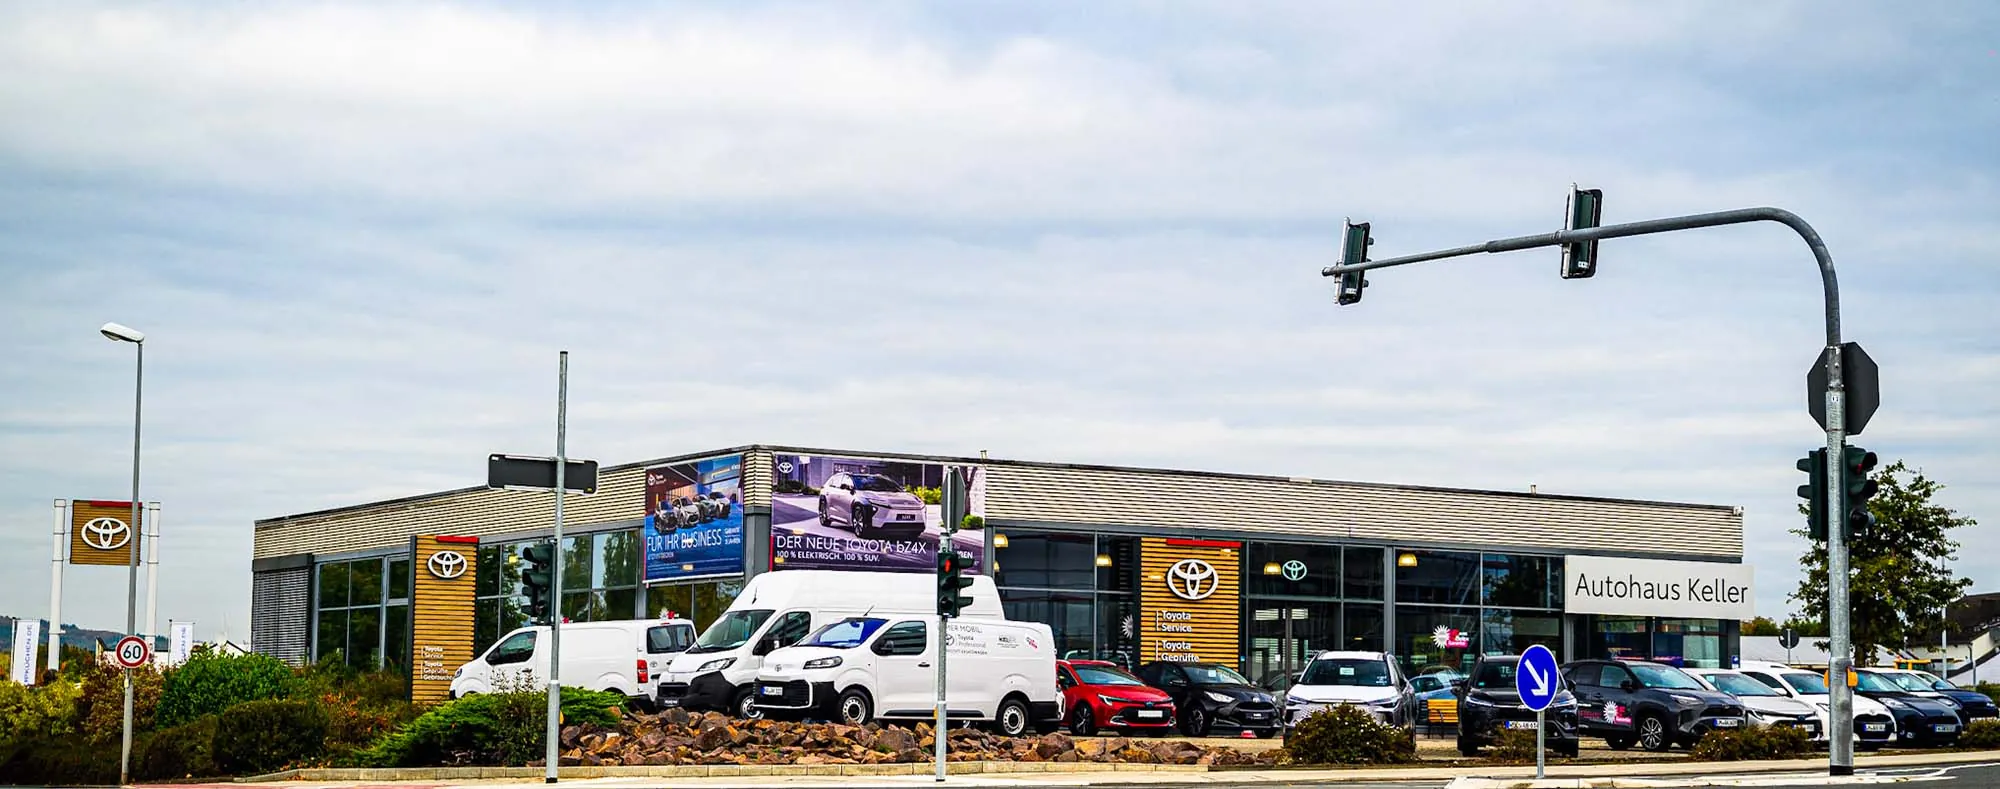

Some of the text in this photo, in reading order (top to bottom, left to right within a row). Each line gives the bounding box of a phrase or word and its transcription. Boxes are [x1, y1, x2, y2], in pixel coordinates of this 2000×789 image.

[664, 532, 679, 551] IHR
[681, 529, 722, 549] BUSINESS
[776, 535, 927, 555] DER NEUE TOYOTA bZ4X
[776, 550, 880, 562] 100 % ELEKTRISCH. 100 % SUV.
[1574, 572, 1748, 604] Autohaus Keller
[1161, 609, 1192, 622] Toyota
[1161, 622, 1193, 632] Service
[123, 644, 142, 660] 60
[423, 645, 443, 653] Toyota
[1161, 639, 1192, 652] Toyota
